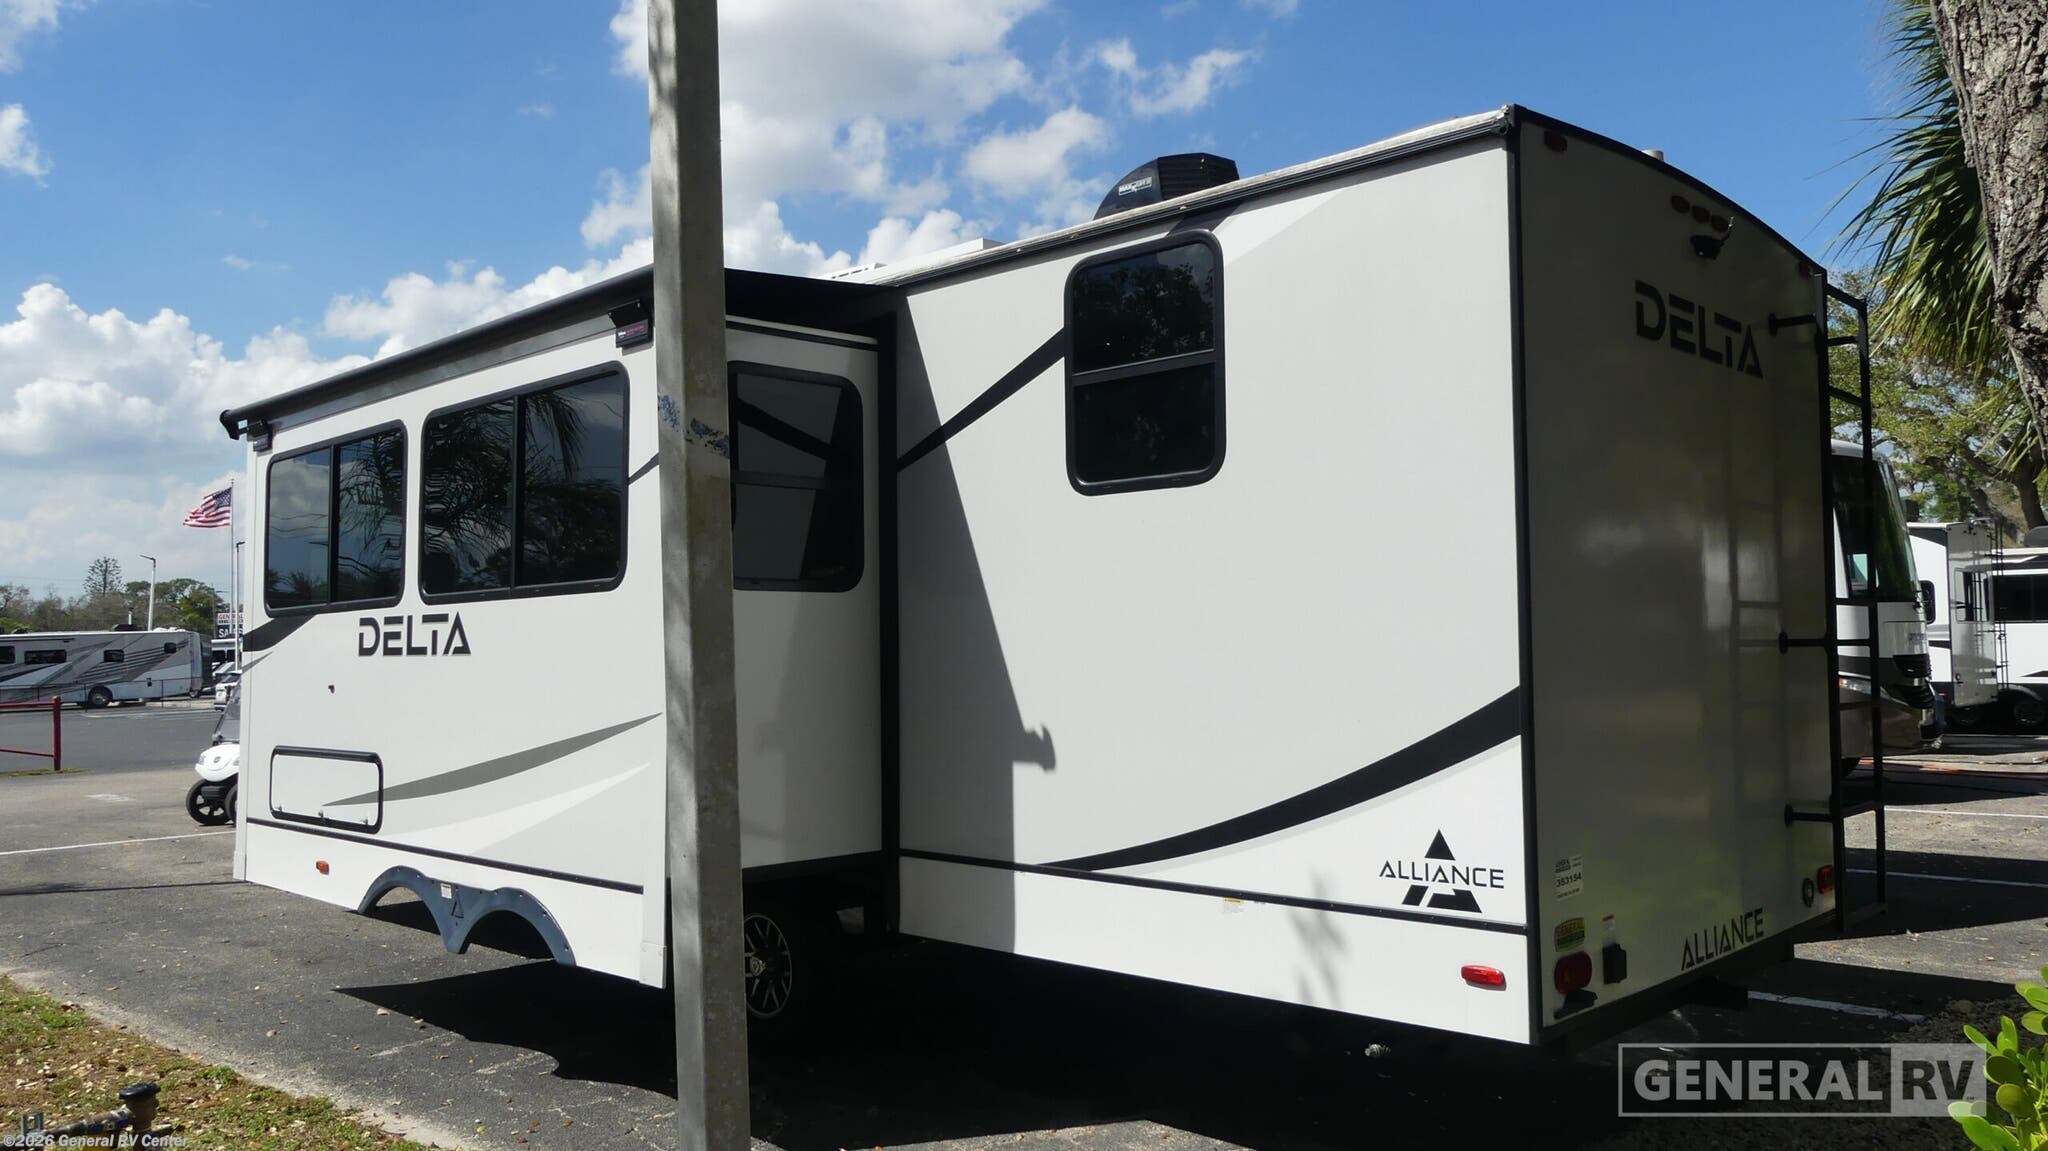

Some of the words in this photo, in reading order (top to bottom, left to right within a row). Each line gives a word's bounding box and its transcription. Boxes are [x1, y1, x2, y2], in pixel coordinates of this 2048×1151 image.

[1634, 279, 1764, 379] DELTA
[358, 611, 472, 656] DELTA
[1379, 859, 1505, 889] ALLIANCE
[1681, 907, 1764, 972] ALLIANCE
